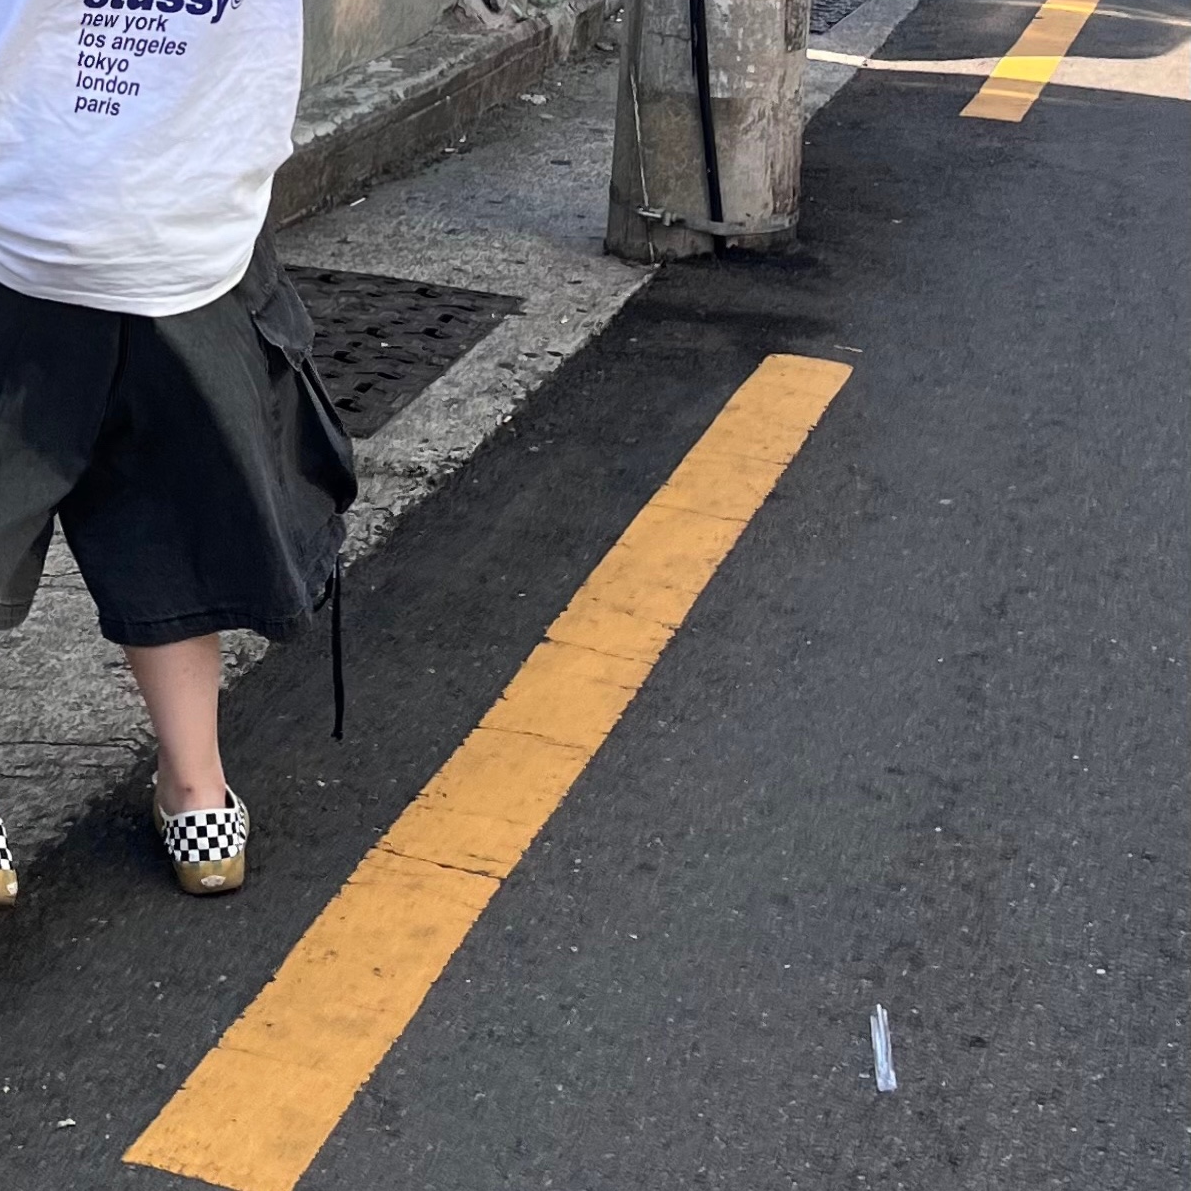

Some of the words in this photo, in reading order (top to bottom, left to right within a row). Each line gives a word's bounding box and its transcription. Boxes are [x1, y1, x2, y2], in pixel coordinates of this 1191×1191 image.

[80, 12, 119, 28] new
[123, 14, 169, 33] york
[78, 28, 106, 48] los
[111, 35, 188, 57] angeles
[77, 51, 129, 75] tokyo
[76, 70, 140, 96] london
[74, 95, 121, 116] paris
